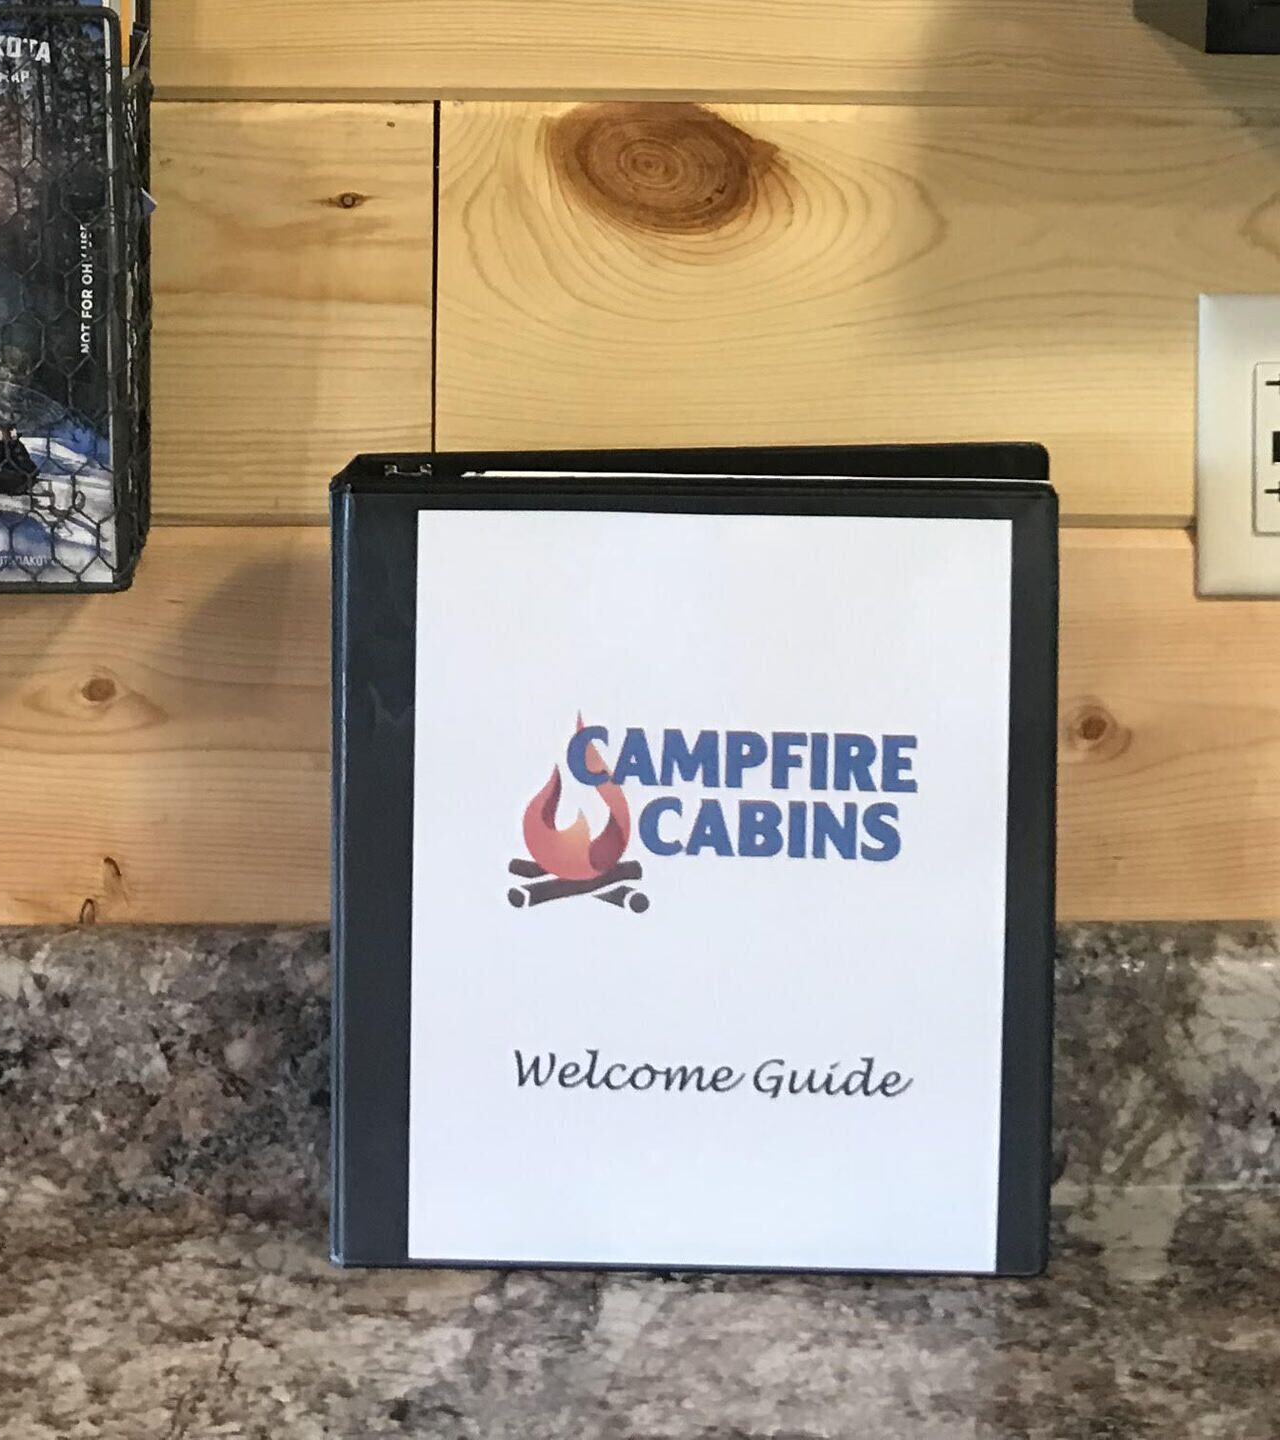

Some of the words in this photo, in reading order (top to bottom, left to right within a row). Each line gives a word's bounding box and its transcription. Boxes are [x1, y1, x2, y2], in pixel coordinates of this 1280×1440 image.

[81, 289, 93, 318] FOR
[80, 323, 91, 354] NOT
[566, 725, 918, 793] CAMPFIRE
[639, 796, 903, 862] CABINS
[514, 1049, 747, 1092] Welcome
[752, 1057, 914, 1098] Guide
